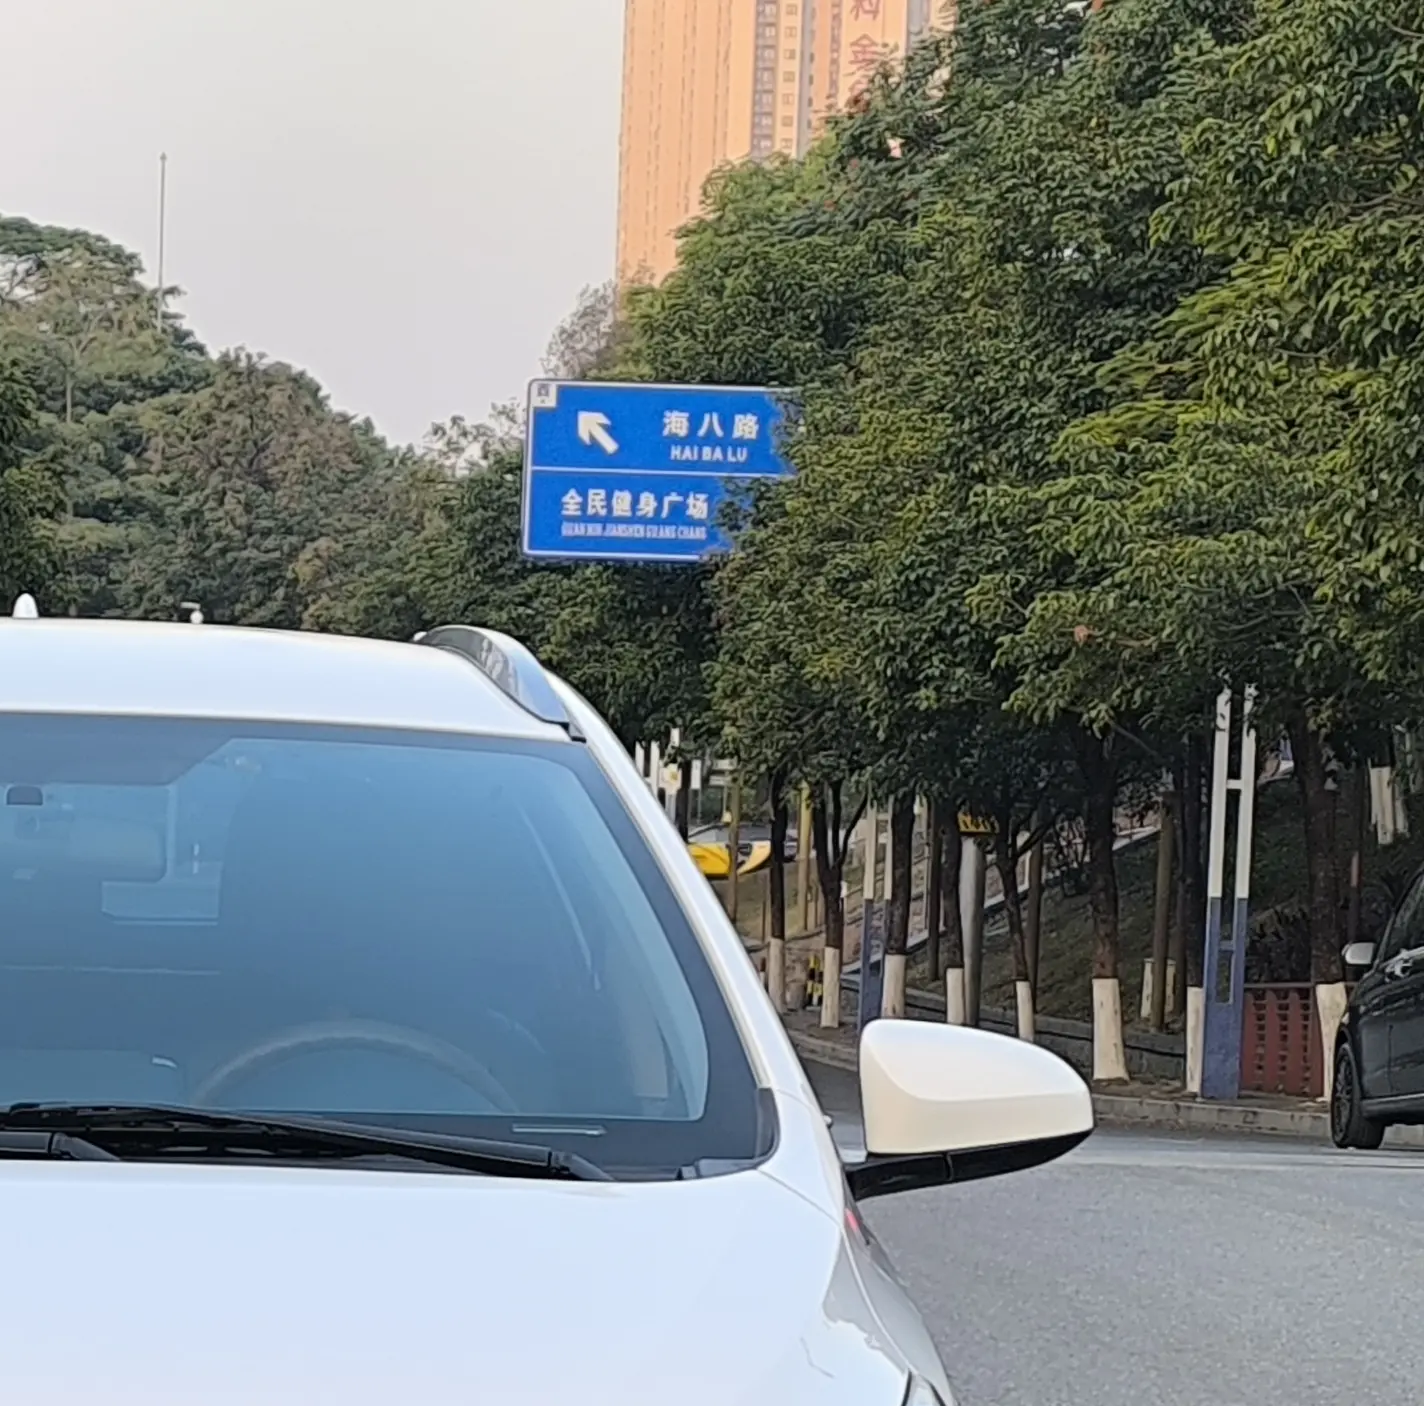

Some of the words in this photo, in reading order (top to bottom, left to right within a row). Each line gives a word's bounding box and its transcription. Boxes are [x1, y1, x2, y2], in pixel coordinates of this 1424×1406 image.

[662, 410, 760, 440] 海八路
[670, 444, 698, 461] HAI
[702, 445, 724, 461] BA
[727, 446, 748, 463] LU
[561, 487, 709, 520] 全民健身广场
